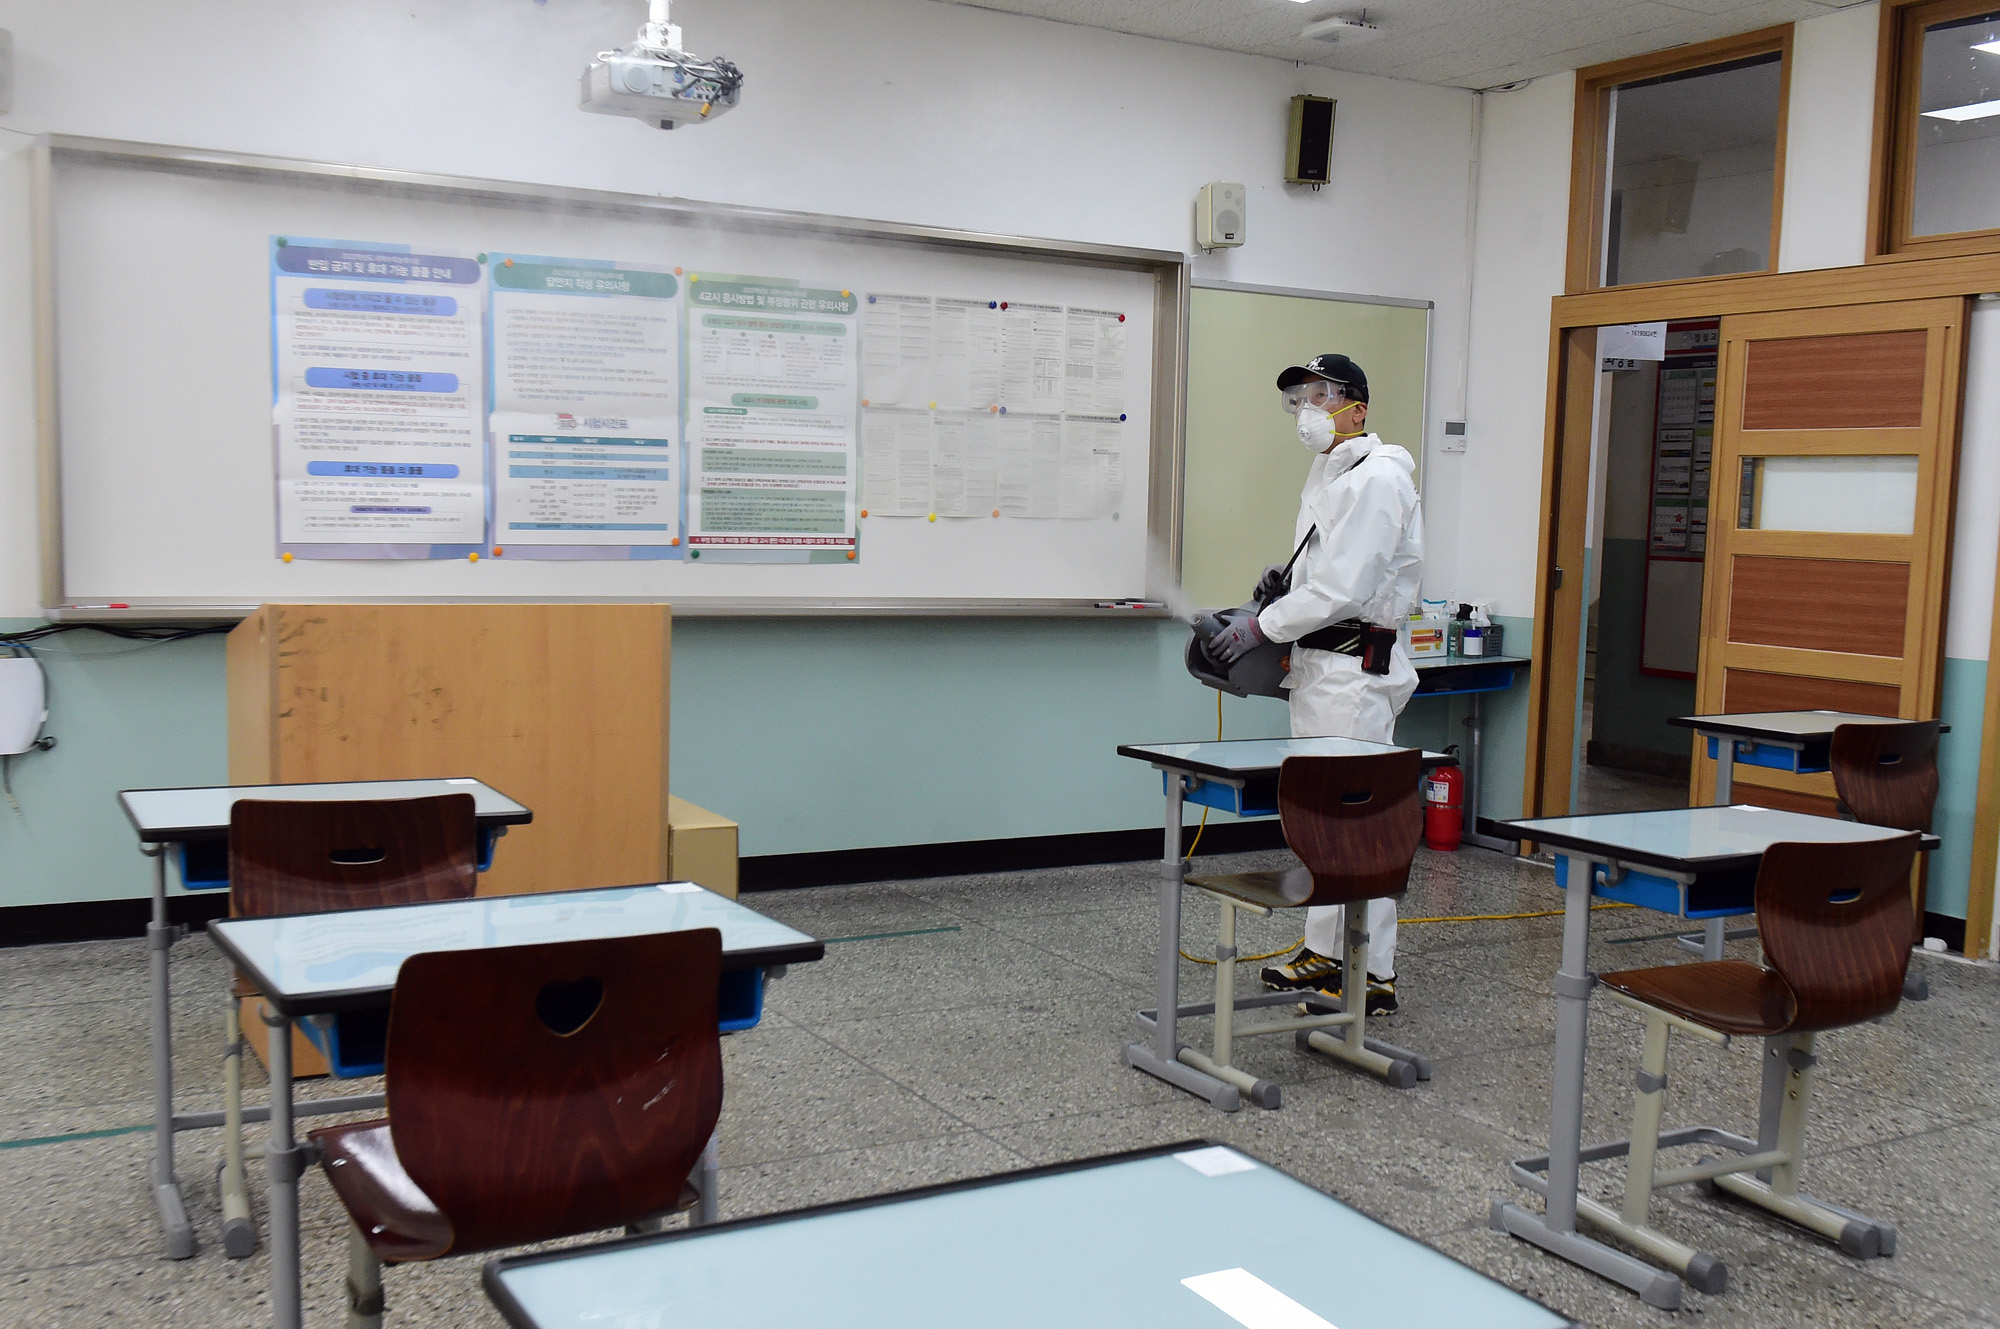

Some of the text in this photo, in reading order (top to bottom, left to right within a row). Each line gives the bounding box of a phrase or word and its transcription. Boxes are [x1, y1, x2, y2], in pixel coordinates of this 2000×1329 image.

[389, 263, 409, 277] 가능
[431, 267, 453, 280] 안내
[545, 276, 631, 293] 답안지 작성 유의사항
[698, 291, 721, 303] 4교시
[722, 292, 754, 305] 응시방법
[756, 295, 765, 306] 및
[767, 295, 799, 308] 부정행위
[817, 299, 849, 312] 유의사항
